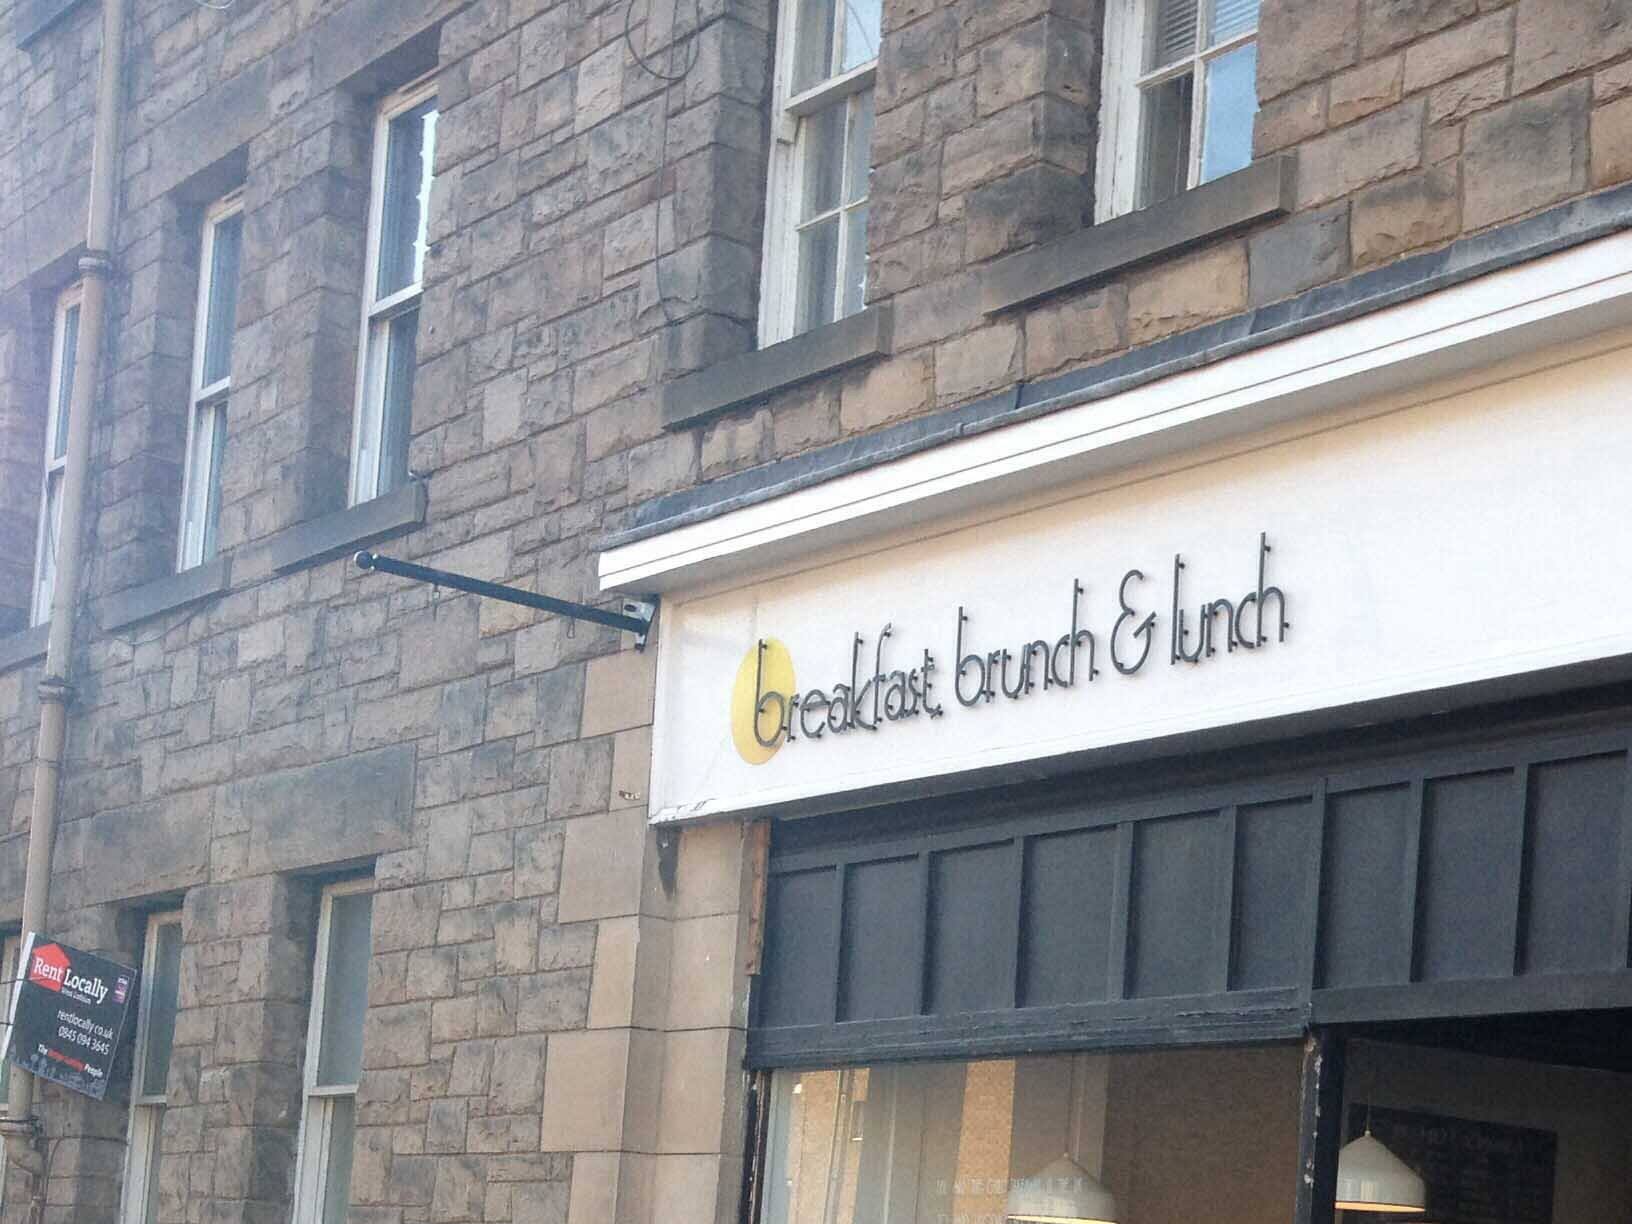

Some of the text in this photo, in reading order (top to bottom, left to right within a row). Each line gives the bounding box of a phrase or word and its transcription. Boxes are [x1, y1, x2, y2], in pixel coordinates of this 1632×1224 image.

[754, 532, 1289, 747] breakfast brunch & lunch
[33, 957, 62, 982] Rent
[64, 969, 109, 1004] Locally
[58, 1026, 77, 1042] 0845
